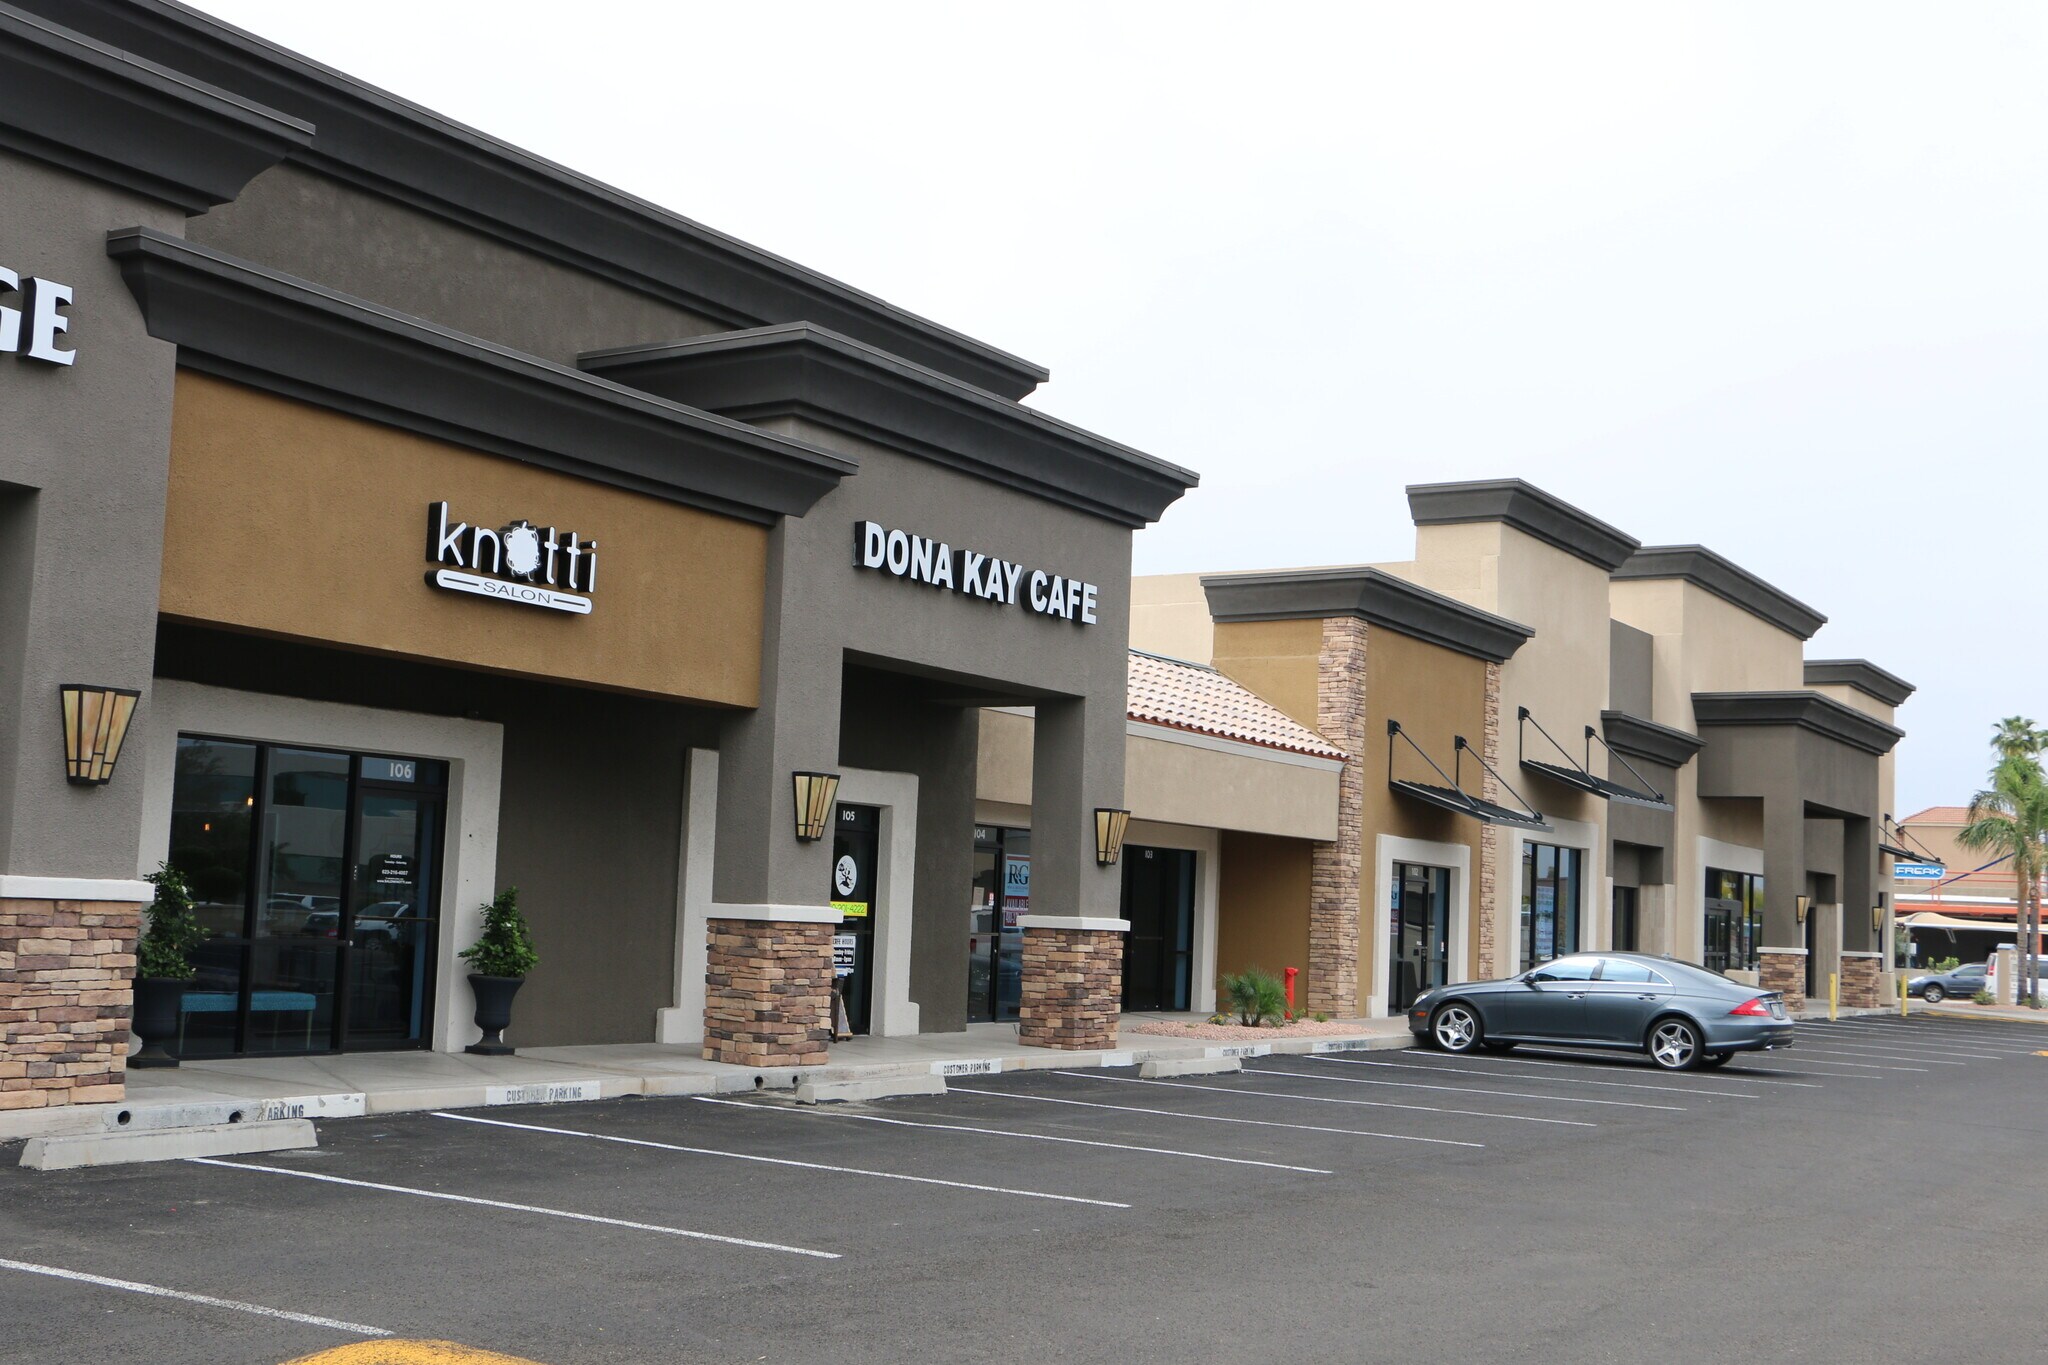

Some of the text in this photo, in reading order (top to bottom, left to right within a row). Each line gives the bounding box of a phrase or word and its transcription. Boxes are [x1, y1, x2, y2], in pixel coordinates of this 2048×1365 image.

[863, 520, 1098, 625] DONA KAY CAFE
[483, 581, 551, 604] SALON
[390, 762, 412, 779] 106
[842, 810, 855, 821] 105
[1895, 866, 1942, 876] FREAK
[943, 1062, 991, 1075] CUSTOMER PARKING
[549, 1087, 582, 1101] PARKING
[267, 1104, 305, 1120] ARKING
